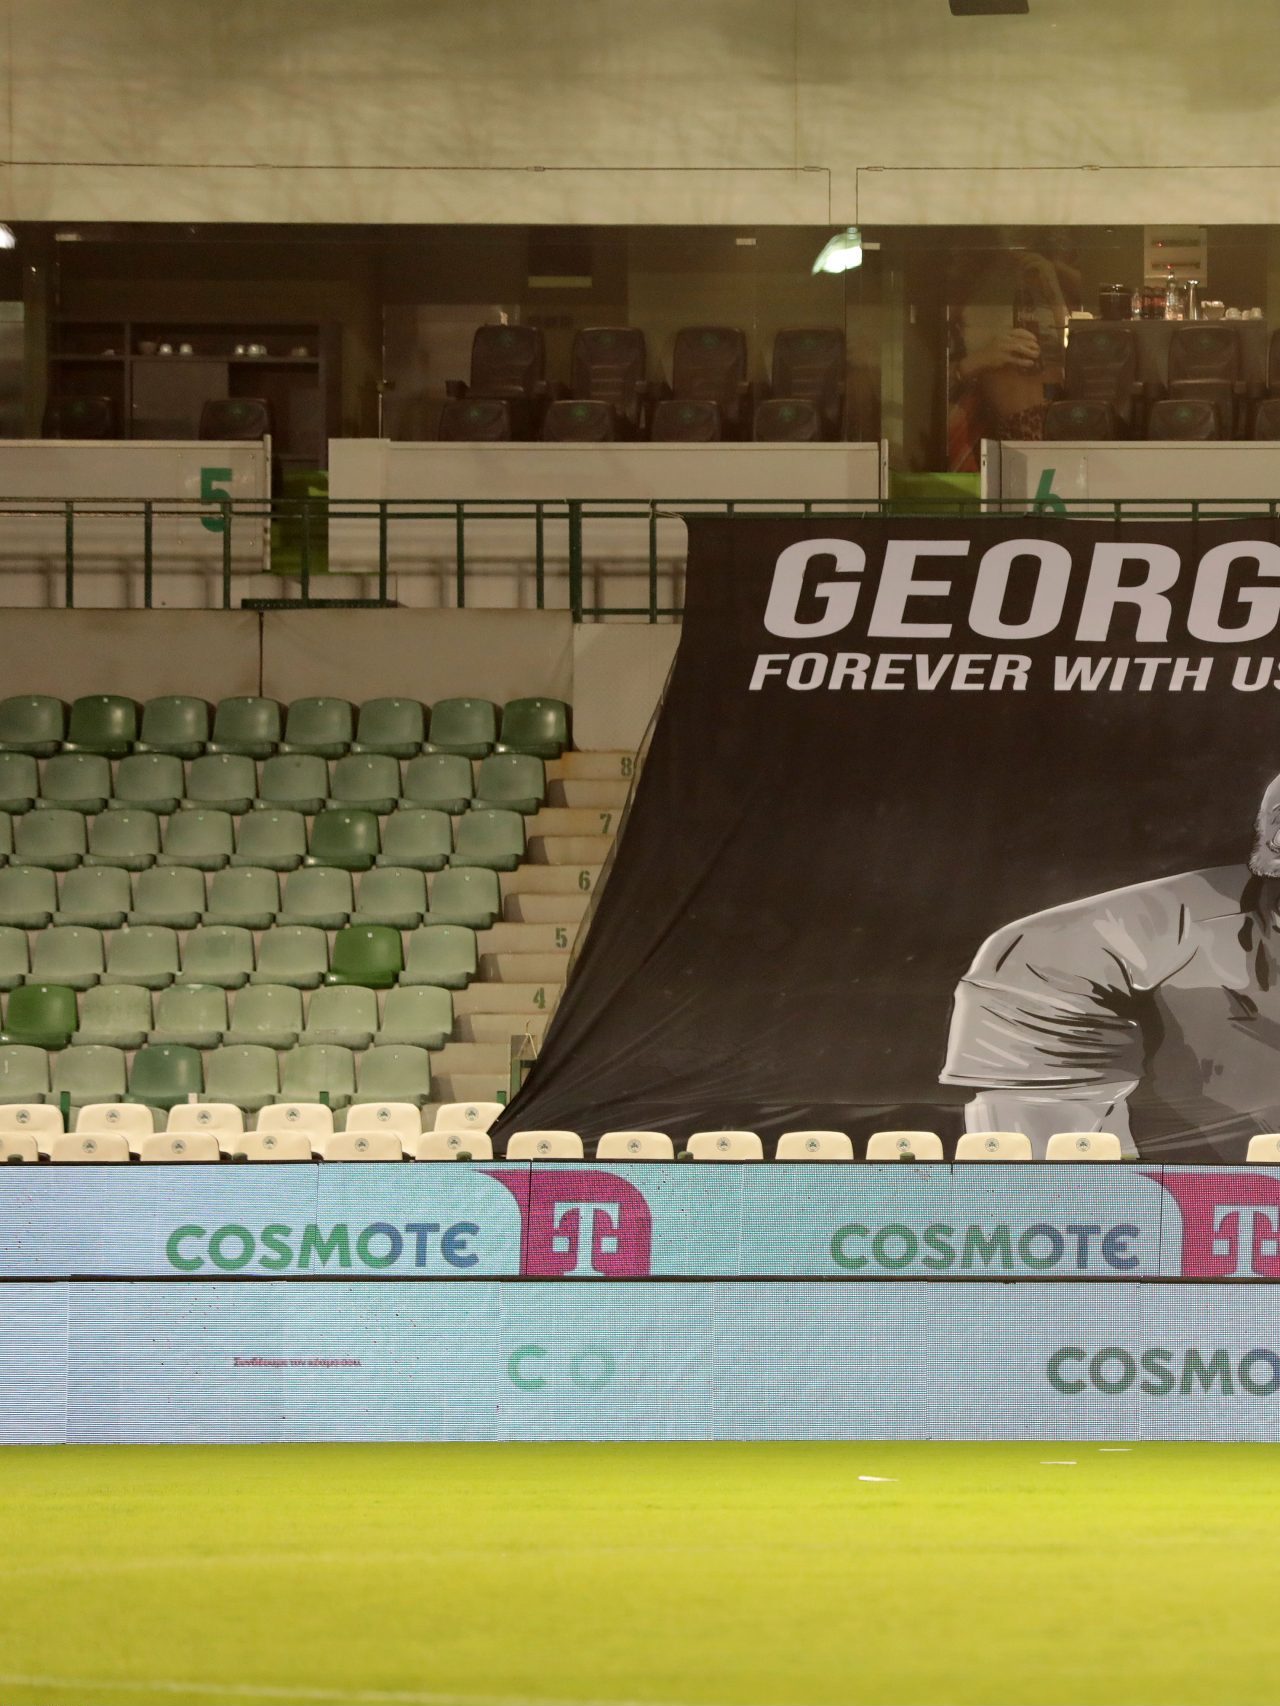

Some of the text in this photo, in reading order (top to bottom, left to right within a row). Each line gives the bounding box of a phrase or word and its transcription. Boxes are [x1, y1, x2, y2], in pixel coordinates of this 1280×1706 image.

[201, 468, 232, 532] 5
[748, 652, 1032, 691] FOREVER
[1054, 656, 1215, 691] WITH
[621, 757, 632, 777] 8
[600, 813, 612, 834] 7
[578, 870, 591, 891] 6
[555, 927, 568, 948] 5
[533, 987, 545, 1009] 4
[166, 1222, 479, 1270] COSMOTE
[832, 1225, 1140, 1270] COSMOTE
